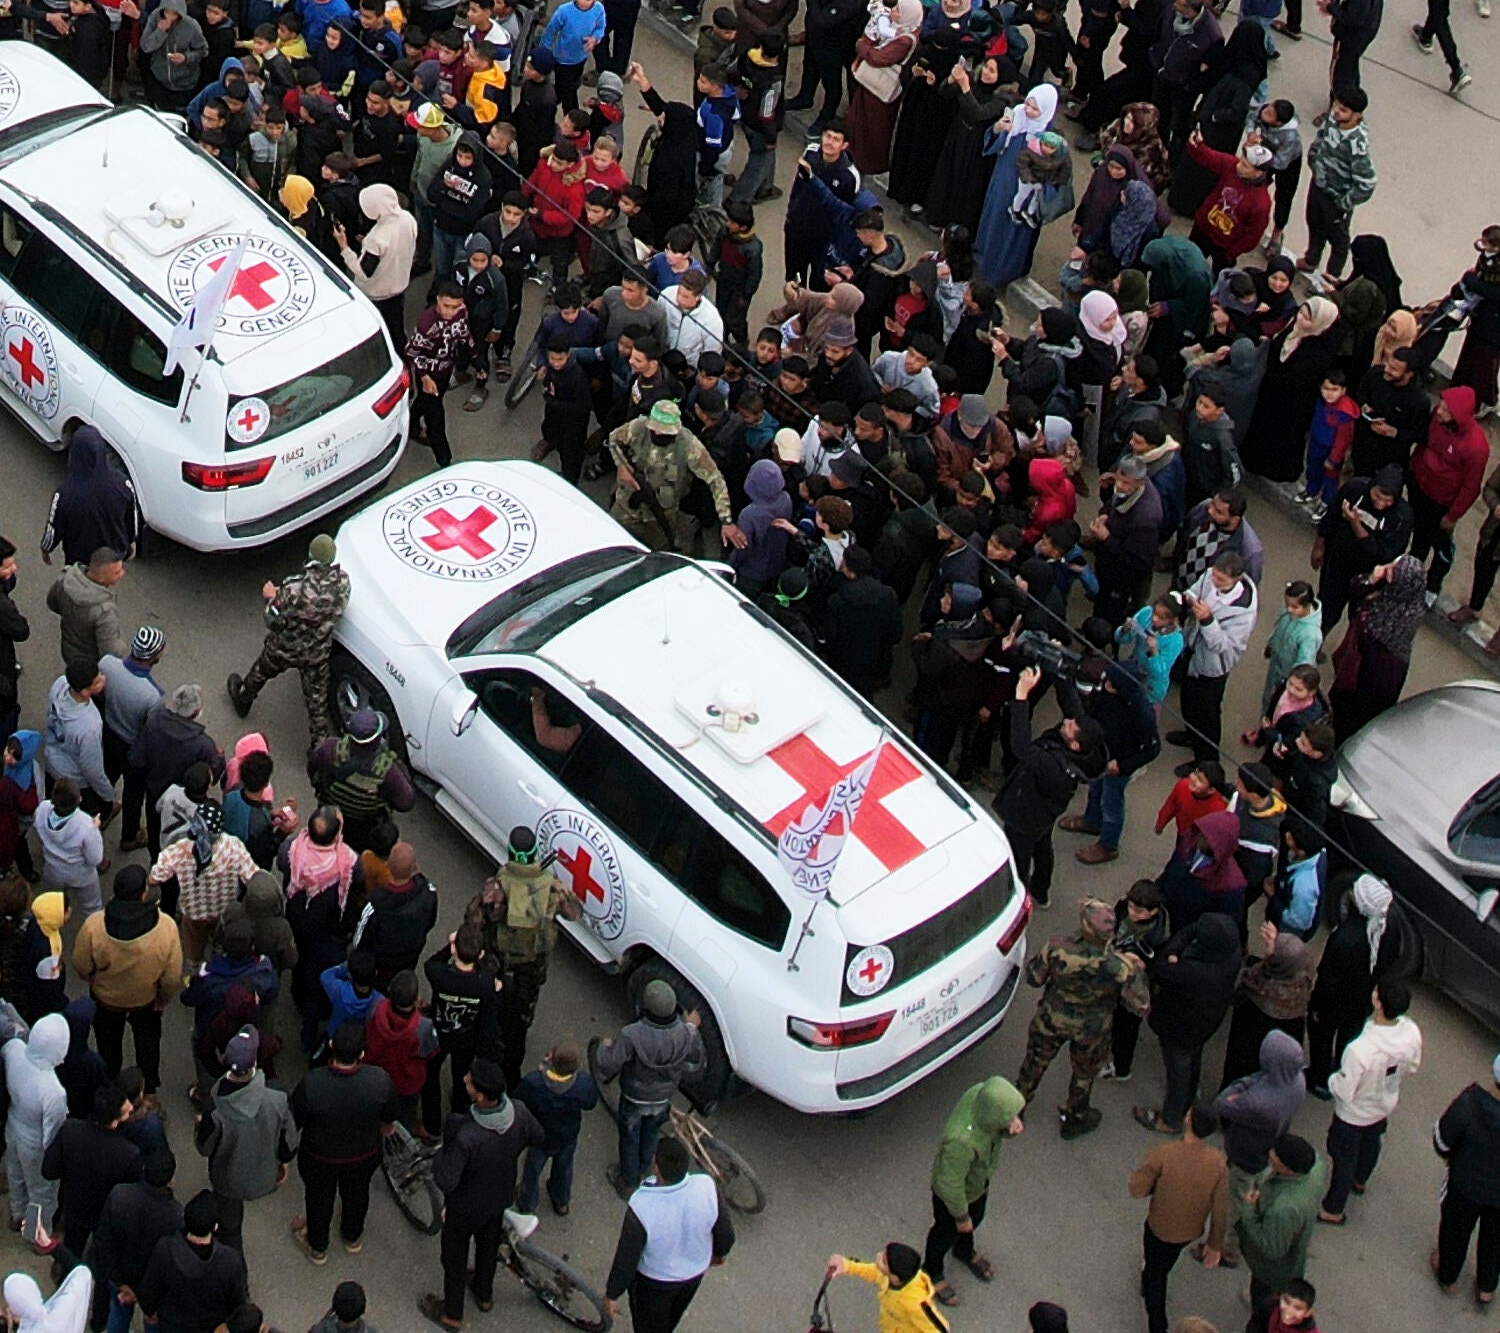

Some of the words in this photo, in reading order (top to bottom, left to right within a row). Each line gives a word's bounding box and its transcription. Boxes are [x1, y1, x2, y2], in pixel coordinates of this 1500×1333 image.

[176, 236, 309, 285] INTERNATIONAL
[240, 292, 309, 333] GENEVE
[389, 482, 458, 522] GENEVE
[471, 484, 531, 533] COMITE
[389, 527, 529, 579] INTERNATIONAL
